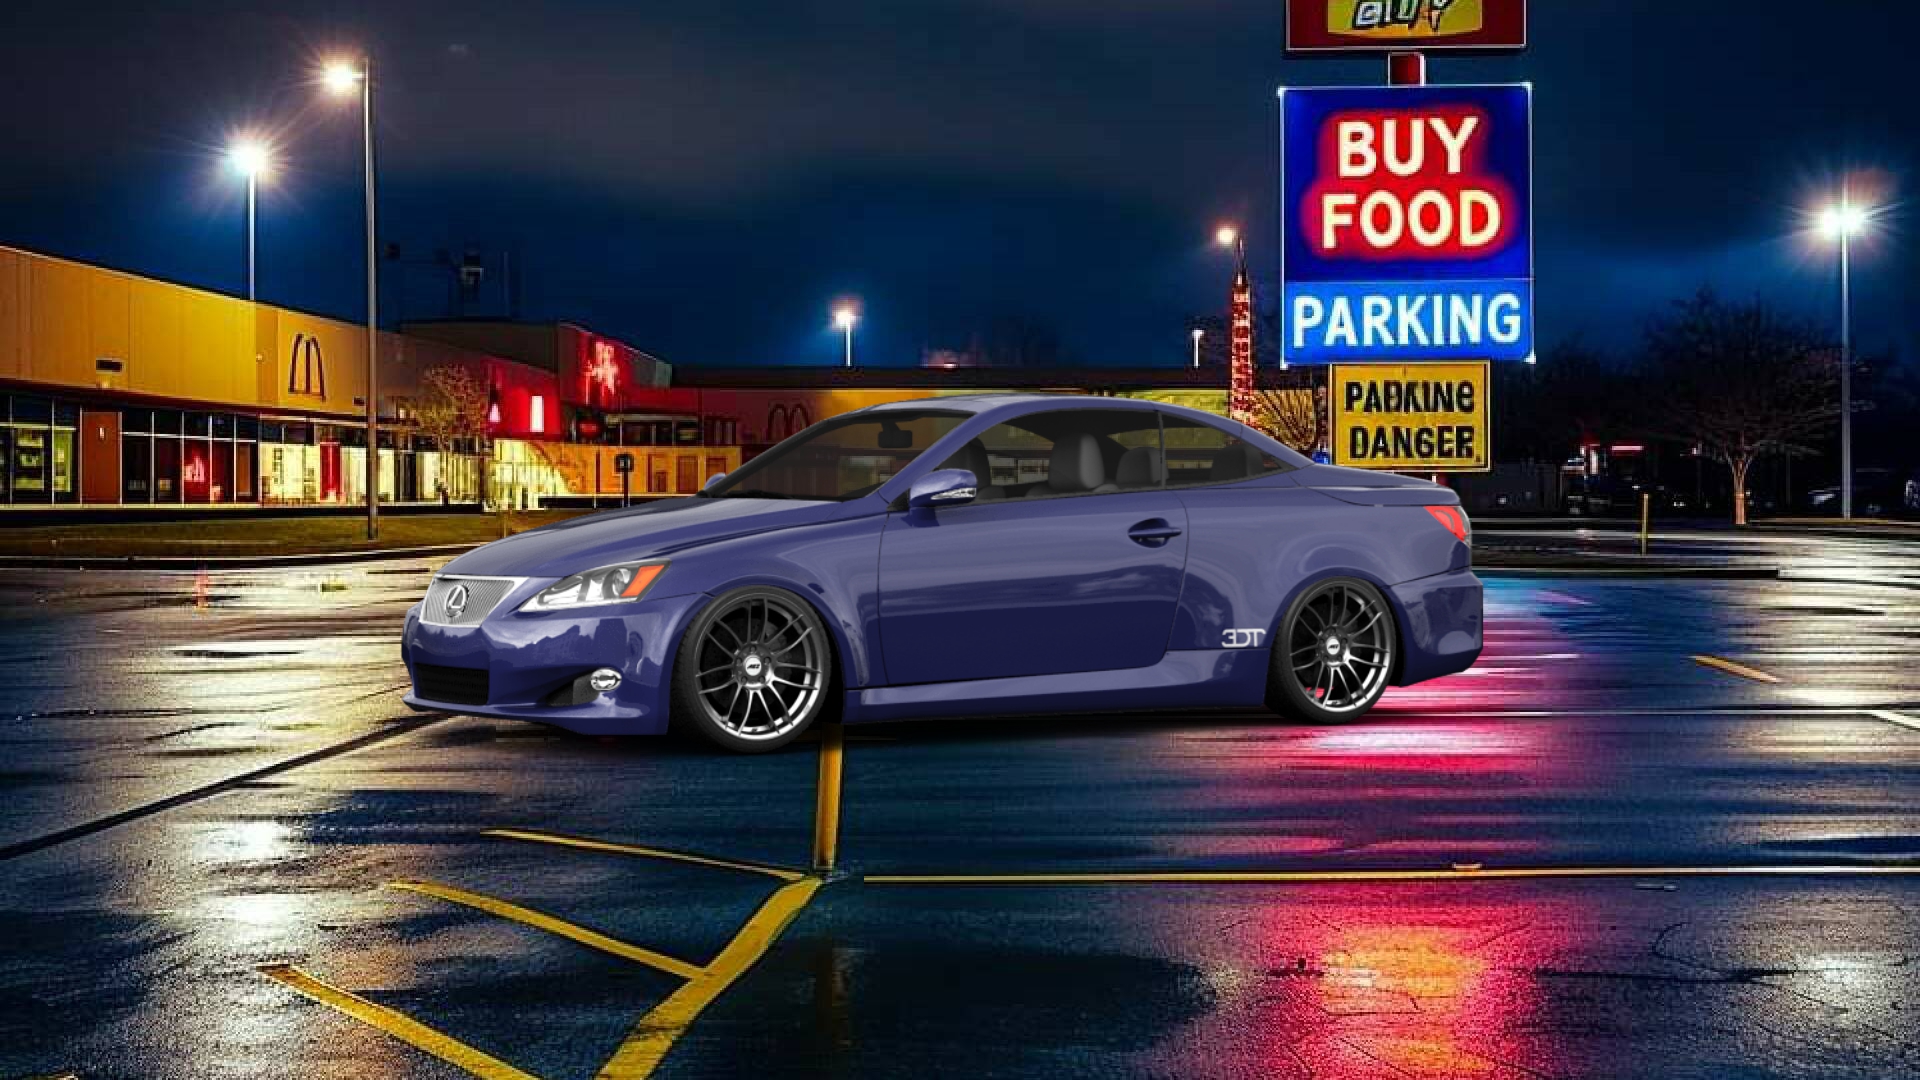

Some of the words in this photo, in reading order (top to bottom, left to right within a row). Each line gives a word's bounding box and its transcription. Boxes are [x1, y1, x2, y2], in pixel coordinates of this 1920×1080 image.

[1338, 116, 1478, 177] BUY
[1323, 190, 1501, 248] FOOD
[1293, 293, 1521, 348] PARKING
[1350, 426, 1474, 459] DANGER
